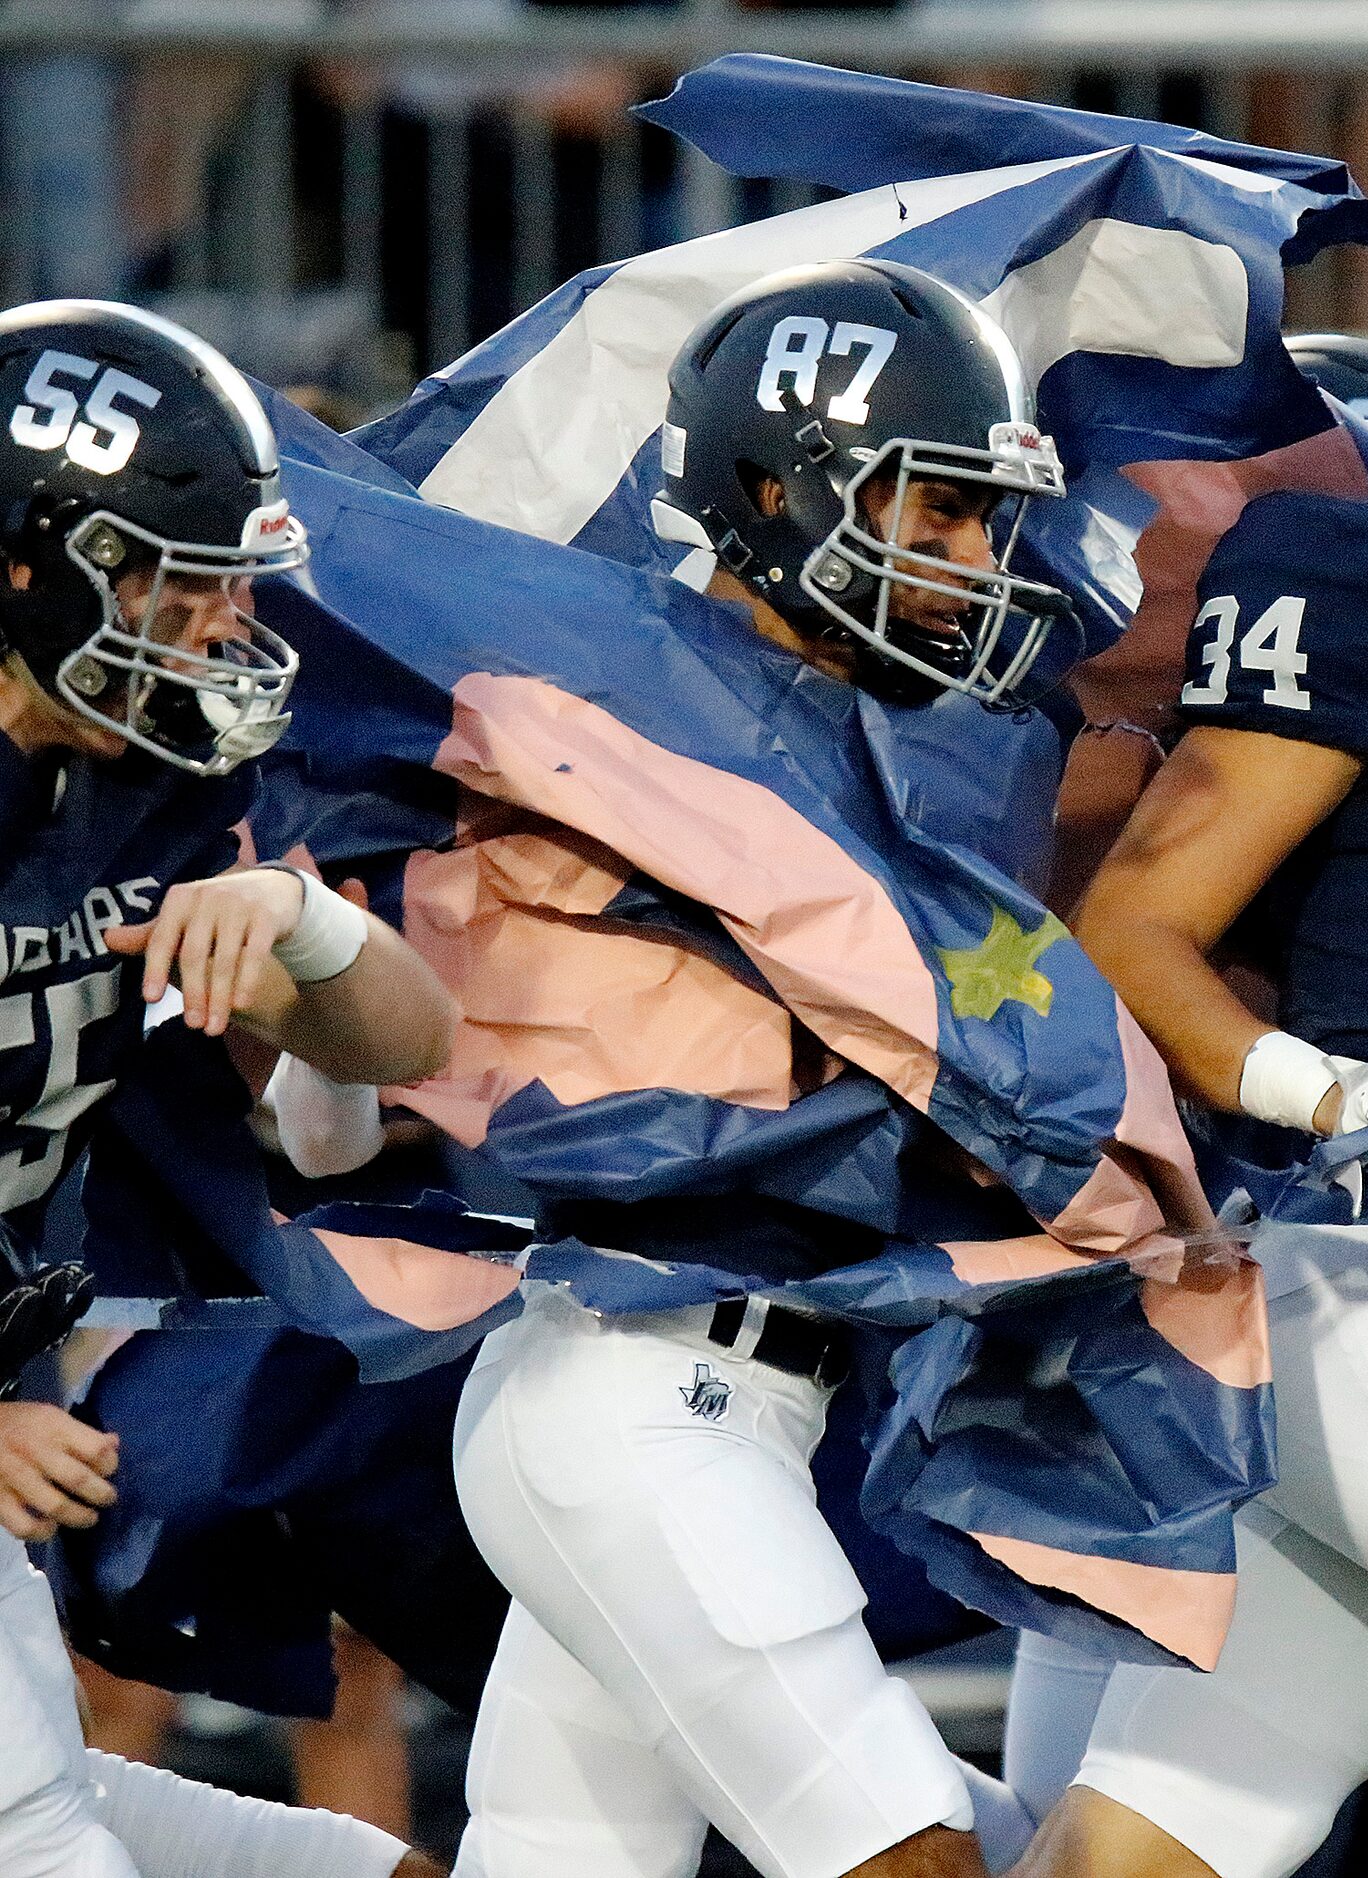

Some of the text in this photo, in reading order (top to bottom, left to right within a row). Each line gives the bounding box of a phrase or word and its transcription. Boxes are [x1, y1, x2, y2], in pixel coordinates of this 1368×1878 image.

[10, 349, 162, 475] 55
[757, 315, 898, 426] 87
[1181, 594, 1311, 711] 34
